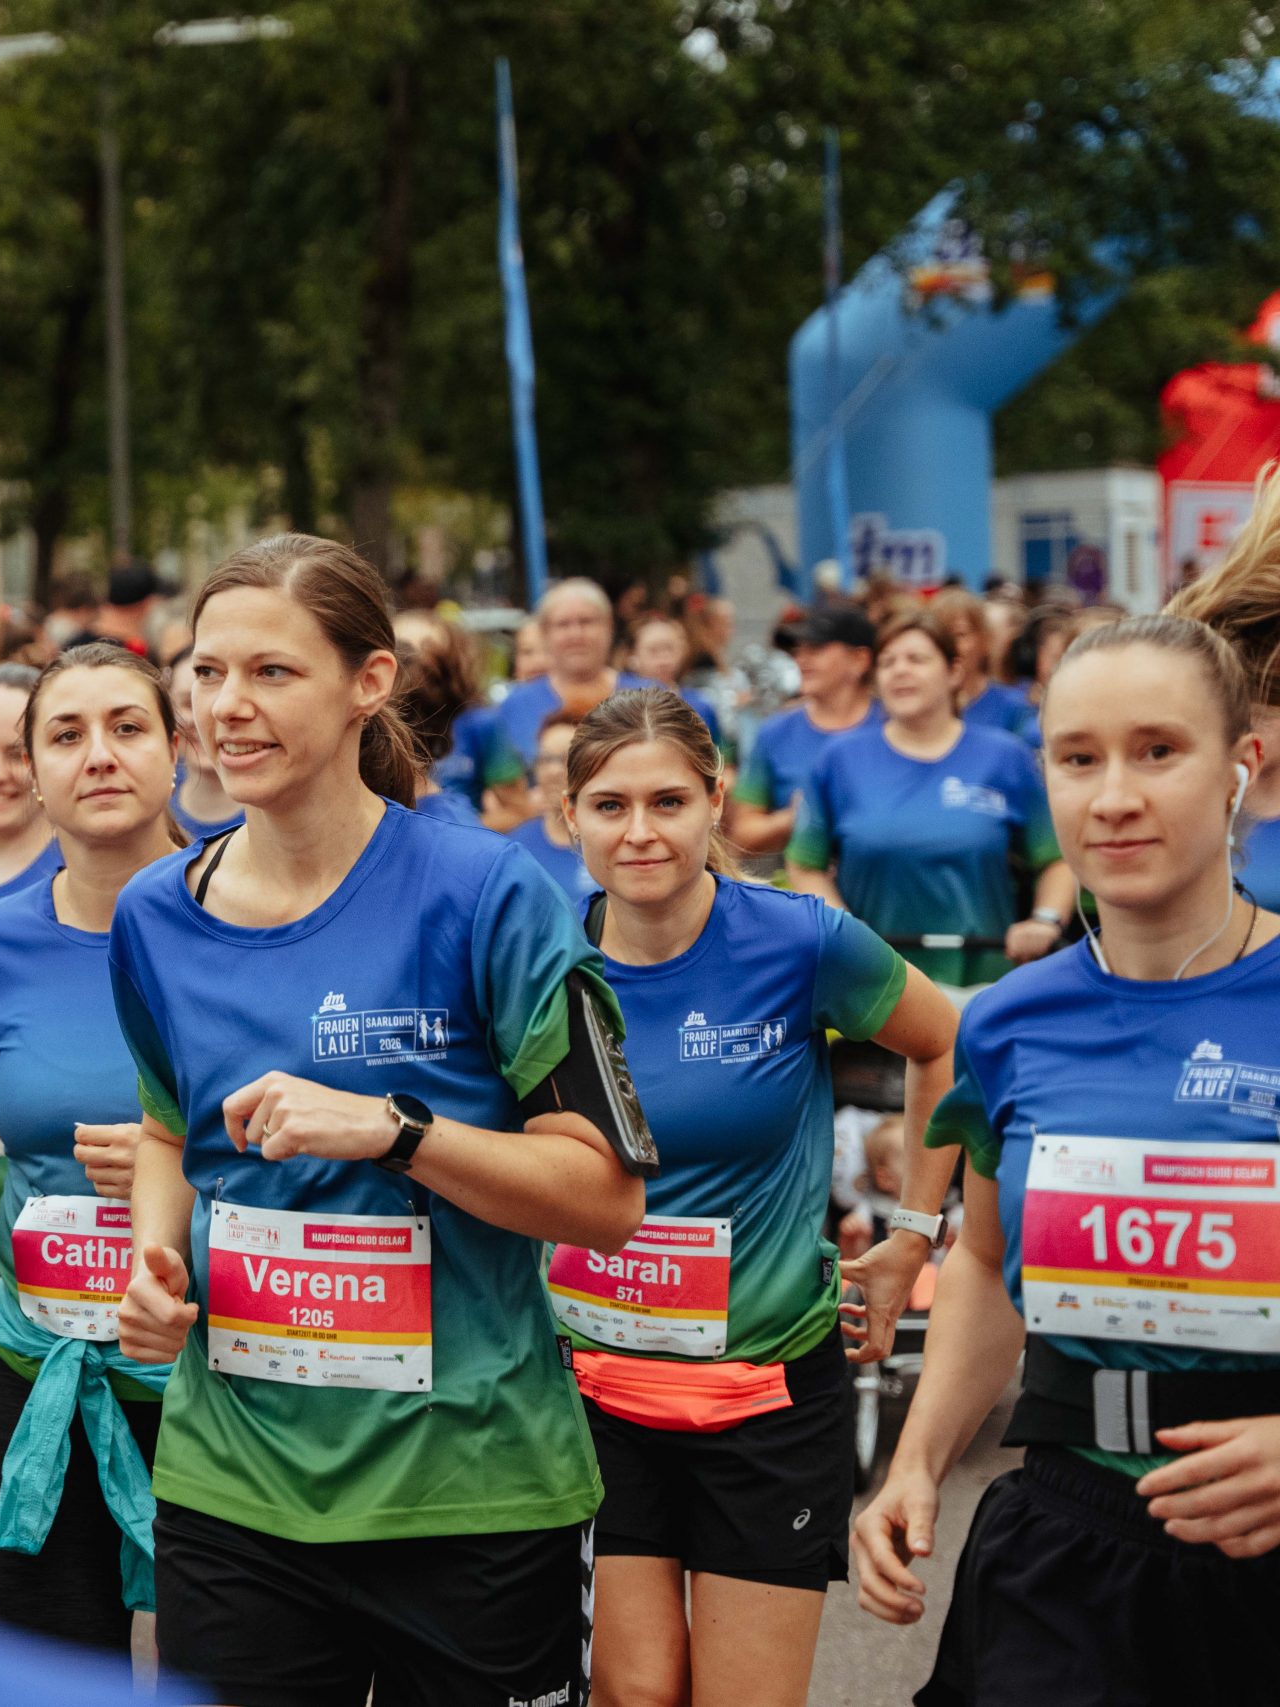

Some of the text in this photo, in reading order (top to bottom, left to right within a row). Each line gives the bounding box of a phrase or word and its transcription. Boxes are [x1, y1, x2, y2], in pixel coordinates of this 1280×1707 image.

[323, 991, 345, 1005] dm
[318, 1017, 359, 1035] FRAUEN
[365, 1014, 414, 1028] SAARLOUIS
[684, 1029, 717, 1042] FRAUEN
[722, 1026, 759, 1038] SAARLOUIS
[318, 1033, 359, 1056] LAUF
[379, 1038, 402, 1051] 2026
[684, 1041, 717, 1057] LAUF
[732, 1043, 750, 1054] 2026
[1187, 1067, 1234, 1079] FRAUEN
[1180, 1080, 1230, 1096] LAUF
[312, 1232, 355, 1244] HAUPTSACH
[379, 1236, 406, 1246] GELAAF
[1080, 1204, 1237, 1270] 1675
[41, 1234, 133, 1269] Cathr
[587, 1250, 681, 1286] Sarah
[85, 1275, 115, 1291] 440
[242, 1256, 386, 1303] Verena
[616, 1286, 643, 1303] 571
[289, 1306, 334, 1328] 1205
[234, 1338, 248, 1349] dm
